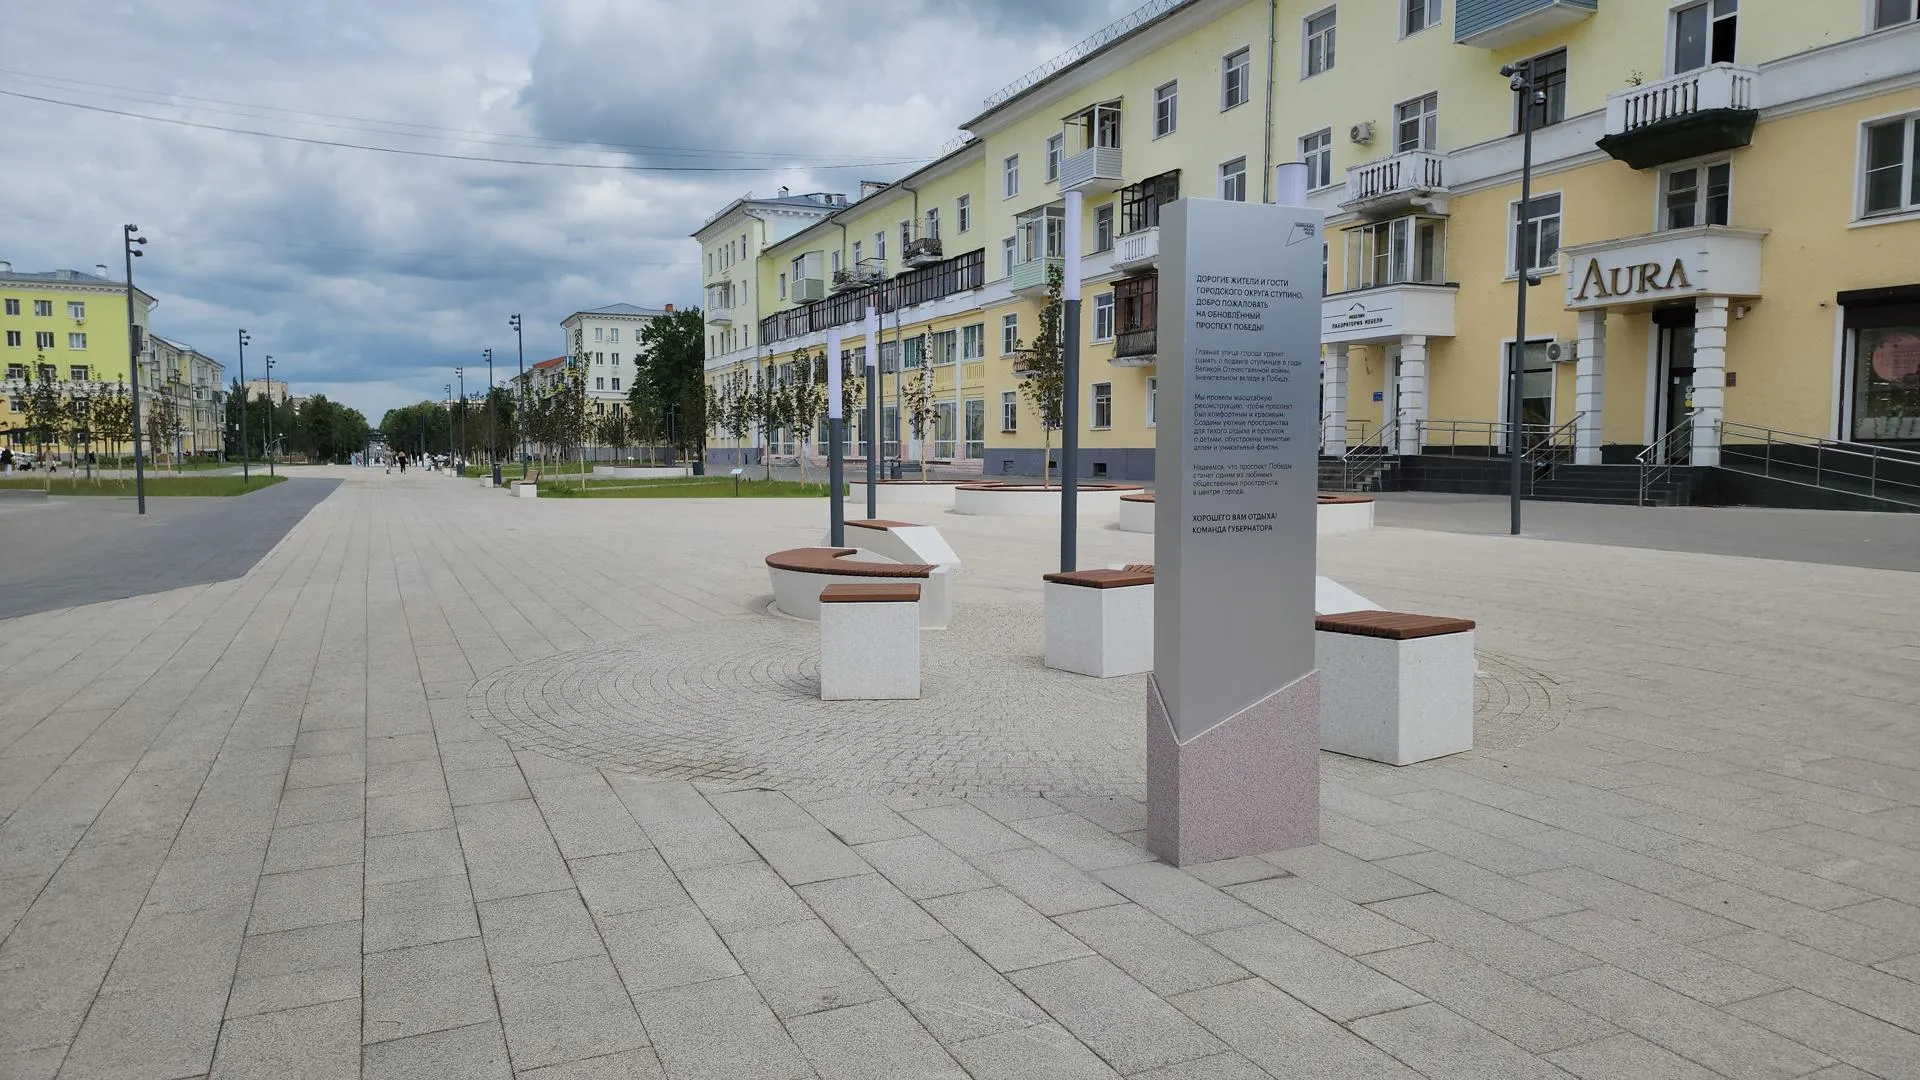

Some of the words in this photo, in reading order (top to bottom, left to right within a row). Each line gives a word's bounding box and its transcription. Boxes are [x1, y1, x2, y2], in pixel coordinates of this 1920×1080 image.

[1197, 275, 1230, 283] ДОРОГИЕ
[1231, 277, 1259, 285] ЖИТЕЛИ
[1267, 279, 1288, 287] ГОСТИ
[1575, 256, 1692, 301] AURA
[1197, 287, 1242, 296] ГОРОДСКОГО
[1271, 291, 1303, 299] СТУПИНО,
[1222, 300, 1268, 308] ПОЖАЛОВАТЬ
[1208, 311, 1260, 319] ОБНОВЛЁННЫЙ
[1332, 321, 1363, 329] ЛАБОРАТОРИЯ
